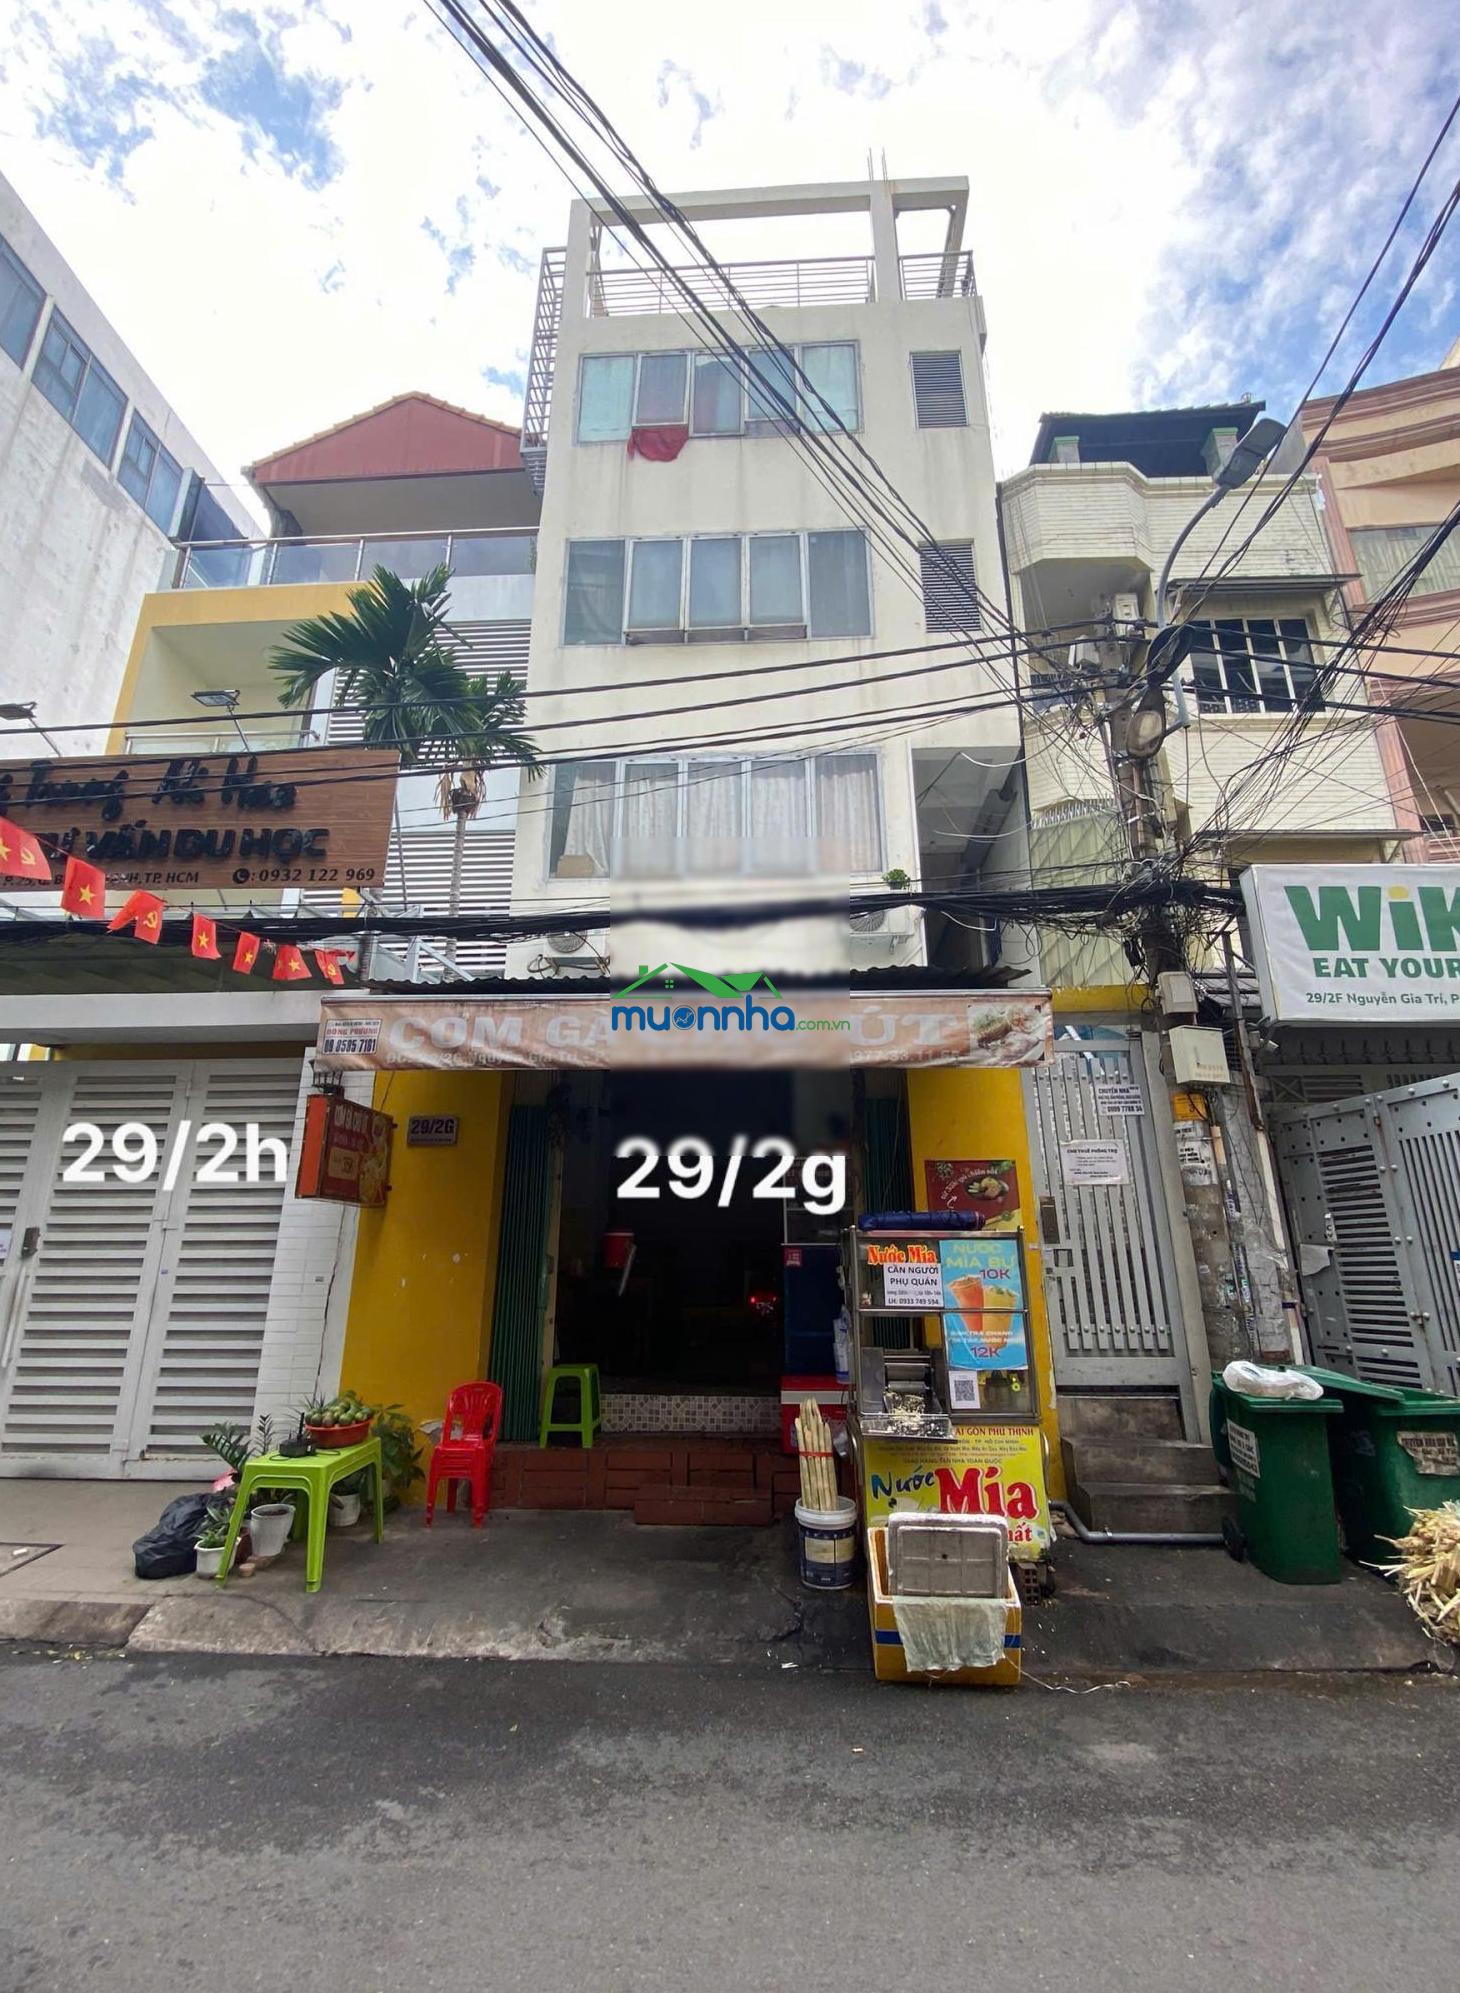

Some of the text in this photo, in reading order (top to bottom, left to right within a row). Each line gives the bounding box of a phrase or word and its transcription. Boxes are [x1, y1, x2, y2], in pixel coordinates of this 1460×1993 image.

[240, 828, 330, 862] HỌC
[165, 872, 199, 883] HCM
[308, 868, 338, 881] 122
[346, 868, 375, 881] 969
[1312, 957, 1369, 978] EAT
[1306, 992, 1343, 1004] 29/2F
[1348, 991, 1397, 1006] Nguyễn
[1401, 993, 1423, 1004] Gia
[411, 1118, 454, 1134] 29/2G
[867, 1244, 938, 1265] Nước Mía
[887, 1265, 939, 1274] CẦN NGƯỜI
[979, 1268, 1011, 1279] 10K
[890, 1276, 937, 1287] PHỤ QUÁN
[971, 1347, 1000, 1358] 12K
[870, 1465, 1039, 1520] Nước Mía
